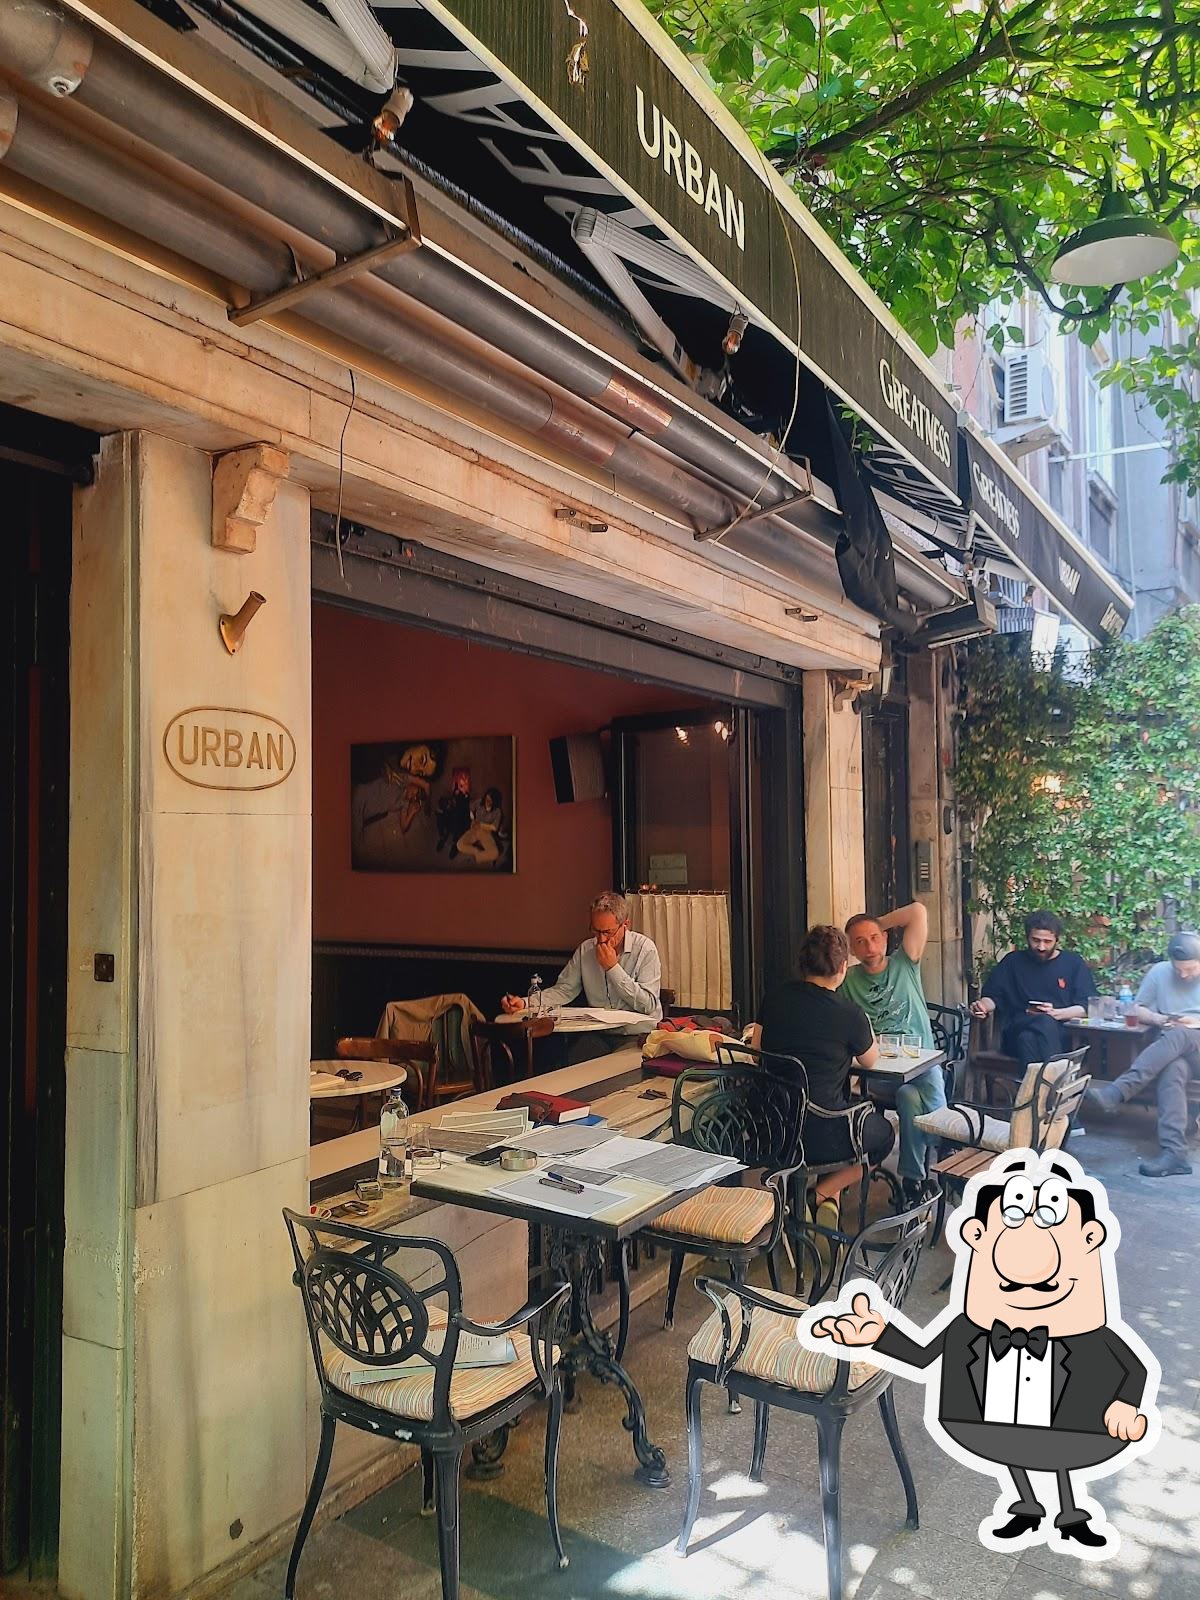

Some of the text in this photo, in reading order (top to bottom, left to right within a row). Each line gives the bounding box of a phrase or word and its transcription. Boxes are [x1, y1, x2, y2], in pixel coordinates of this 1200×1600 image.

[635, 84, 746, 252] URBAN
[879, 358, 951, 469] GREATNESS
[972, 461, 1020, 539] GREATNESS
[178, 724, 284, 771] URBAN
